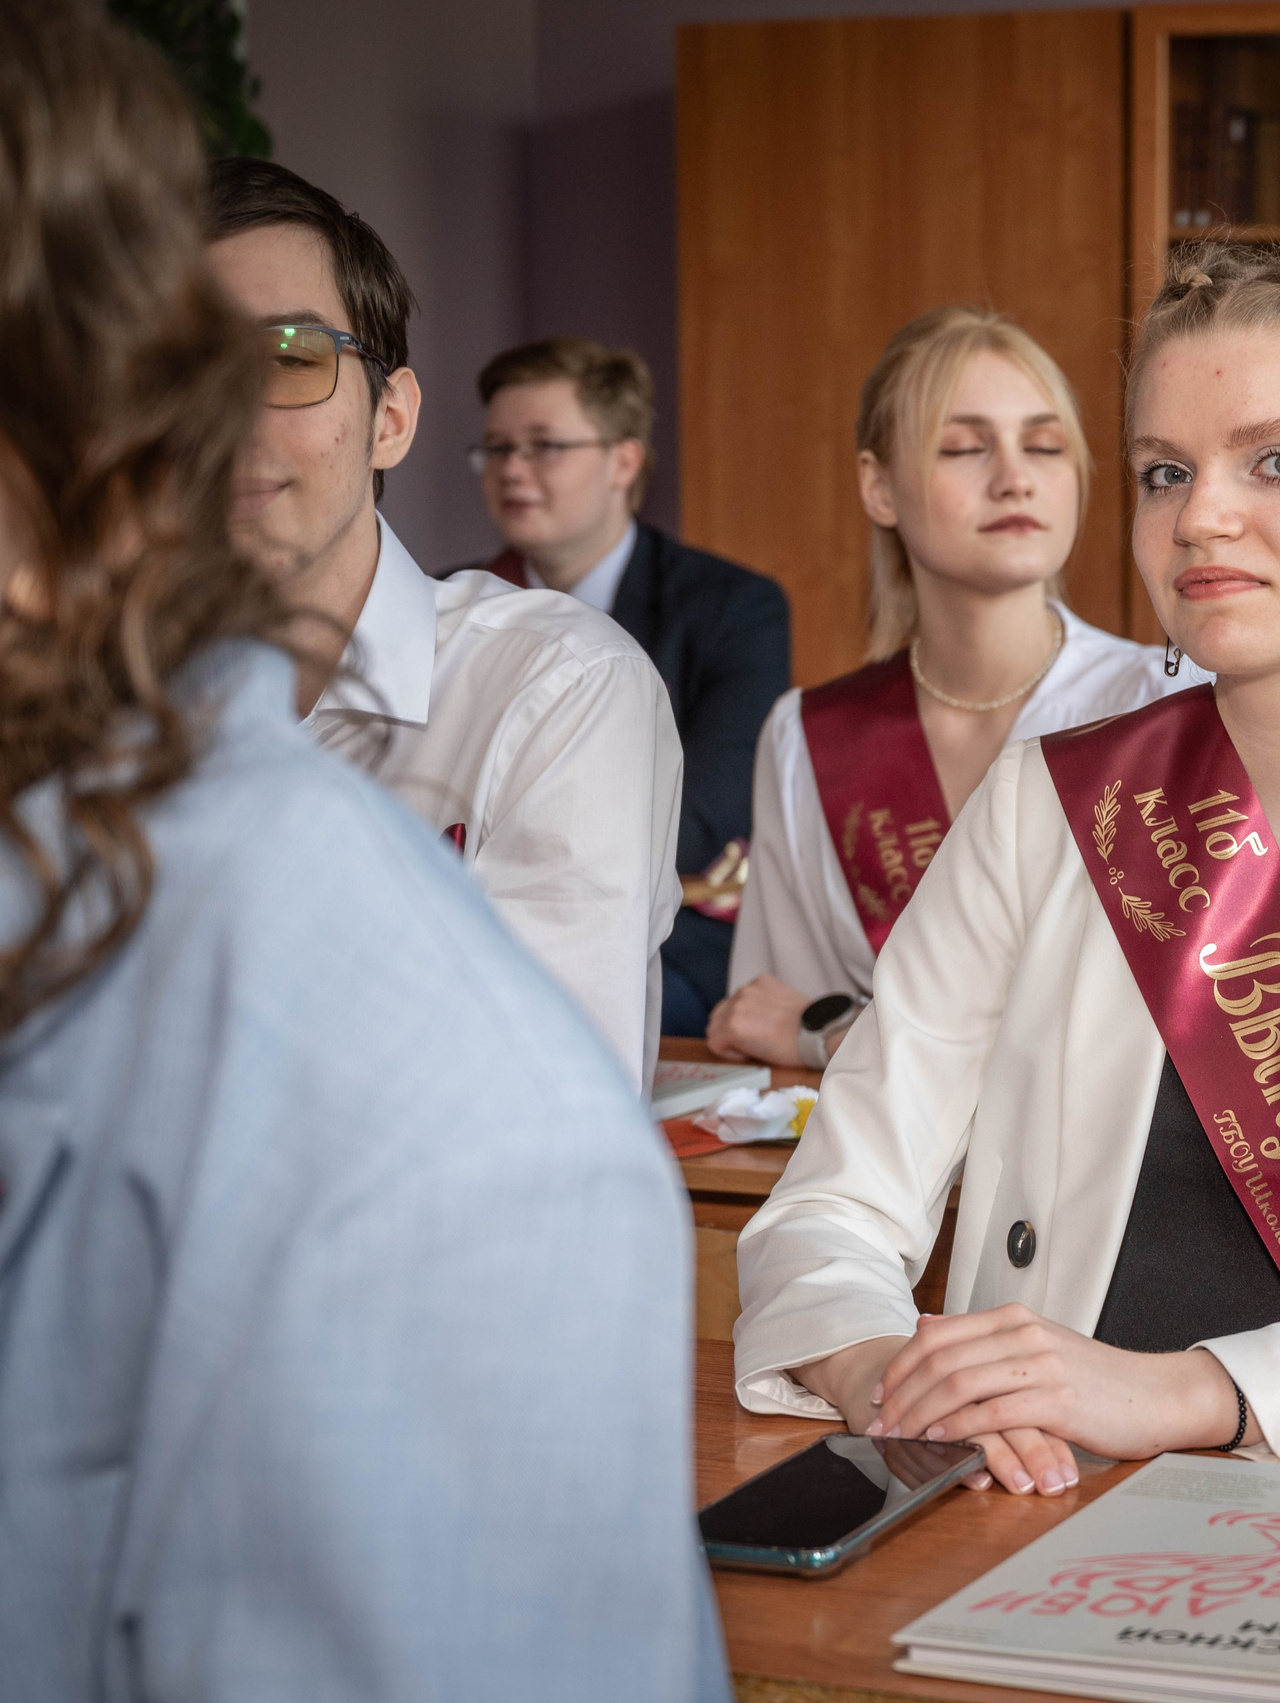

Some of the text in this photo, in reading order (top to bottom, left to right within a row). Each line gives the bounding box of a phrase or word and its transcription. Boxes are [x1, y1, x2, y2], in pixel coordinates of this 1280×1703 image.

[1187, 788, 1269, 861] 11б
[1213, 1109, 1259, 1173] ГБОУ
[966, 1589, 1244, 1619] ЛЮБИ
